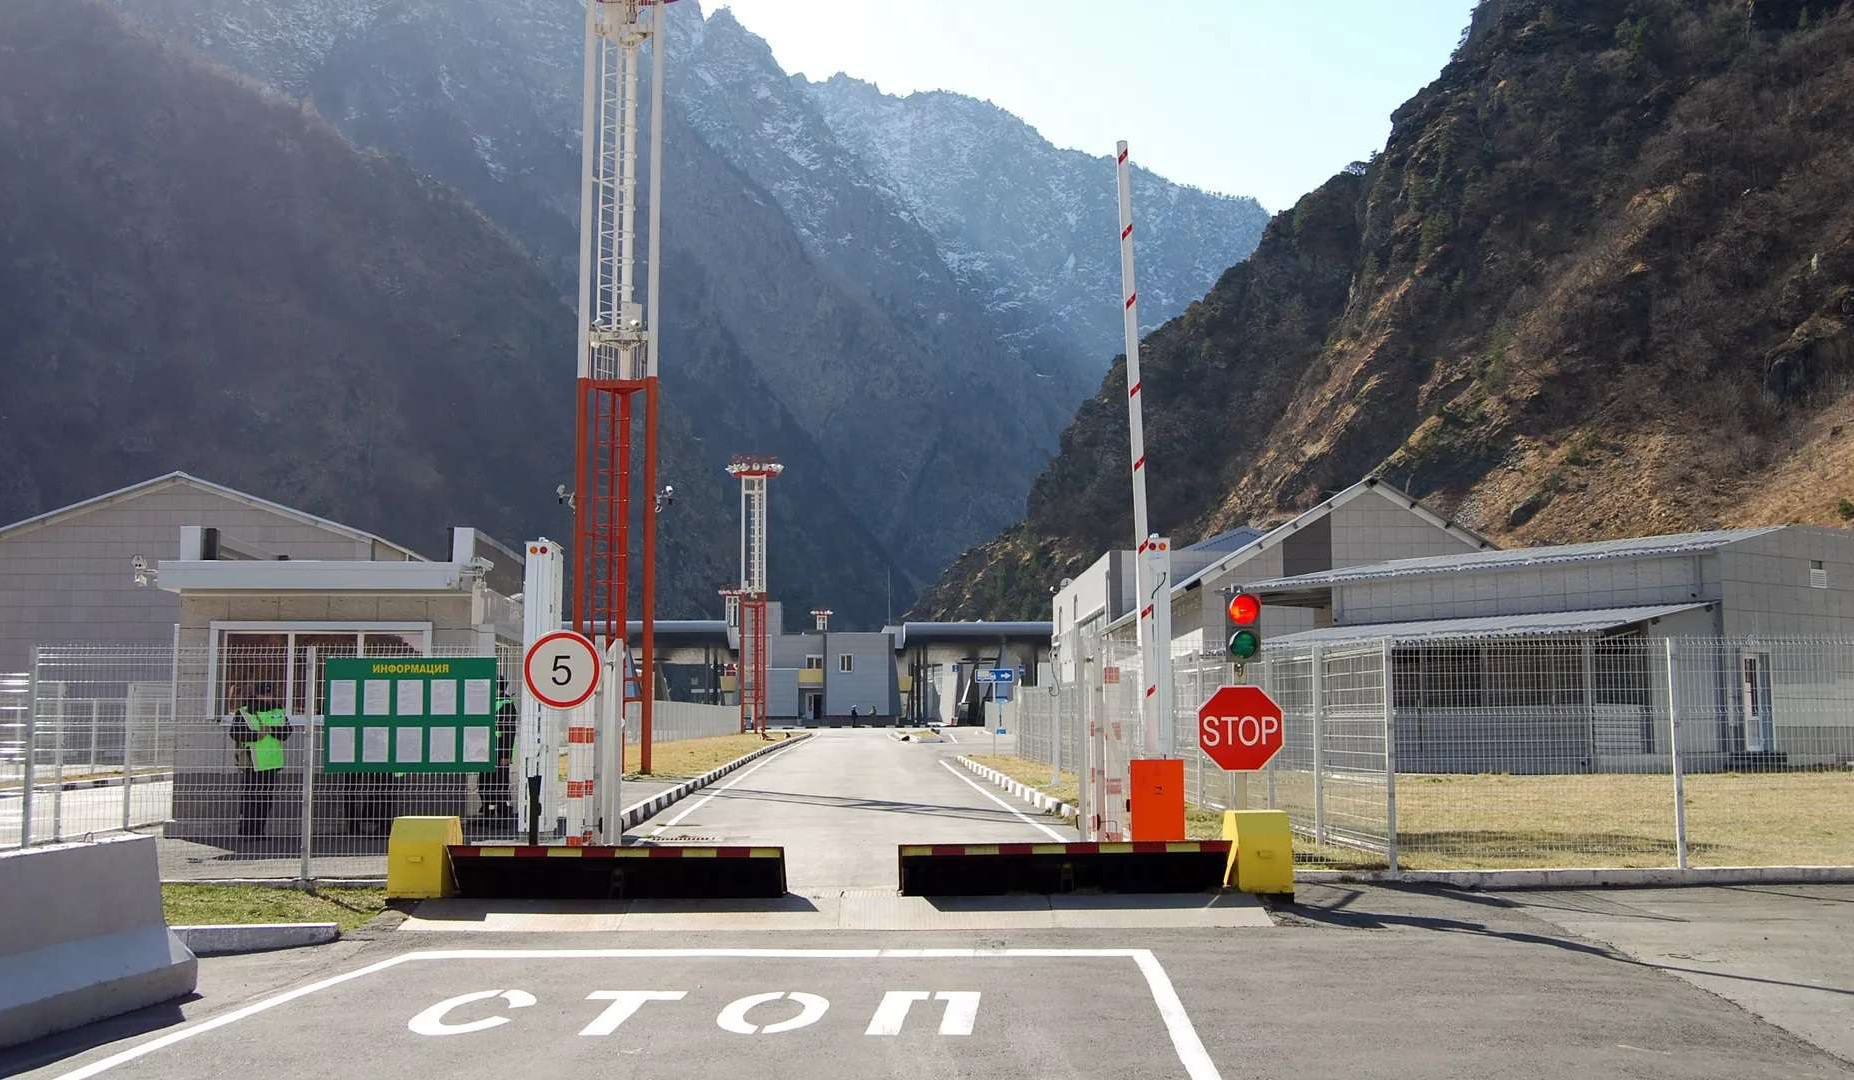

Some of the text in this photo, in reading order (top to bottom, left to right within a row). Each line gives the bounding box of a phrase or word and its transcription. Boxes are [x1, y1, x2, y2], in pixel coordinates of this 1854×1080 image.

[372, 663, 449, 675] ИНФОРМАЦИЯ
[551, 655, 572, 686] 5
[1202, 715, 1279, 747] STOP
[407, 989, 982, 1036] СТОП
